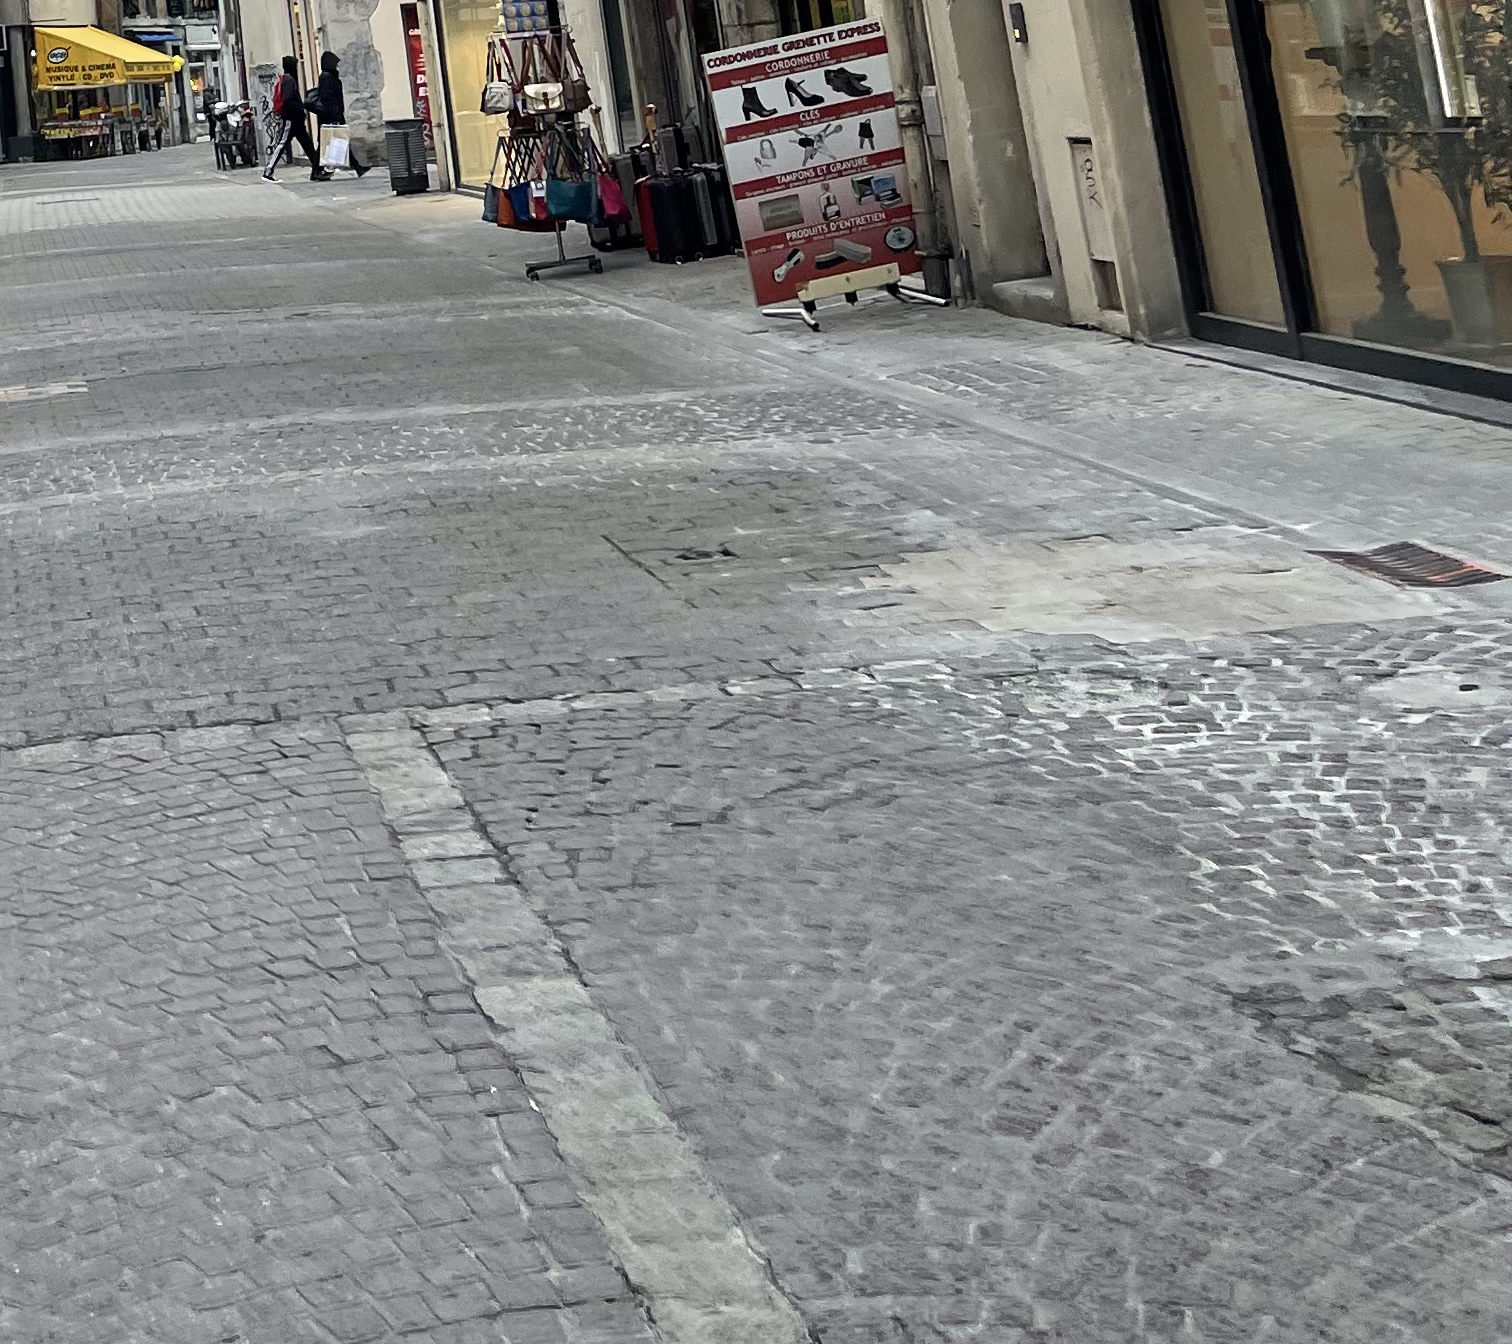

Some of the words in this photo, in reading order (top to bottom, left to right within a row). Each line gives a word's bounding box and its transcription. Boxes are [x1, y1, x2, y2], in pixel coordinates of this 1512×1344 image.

[707, 43, 781, 69] CORDONNERIE
[781, 31, 836, 53] GRENETTE
[837, 22, 882, 41] EXPRESS
[45, 64, 79, 73] MUSIQUE
[88, 62, 117, 72] CINEMA
[765, 50, 831, 73] CORDONNERIE
[82, 73, 93, 81] CD
[99, 72, 115, 80] DVD
[799, 108, 821, 121] CLÉS
[775, 169, 816, 185] TAMPONS
[817, 165, 830, 176] ET
[830, 156, 869, 173] GRAVURE
[786, 224, 828, 241] PRODUITS
[830, 212, 886, 231] D'ENTRETIEN
